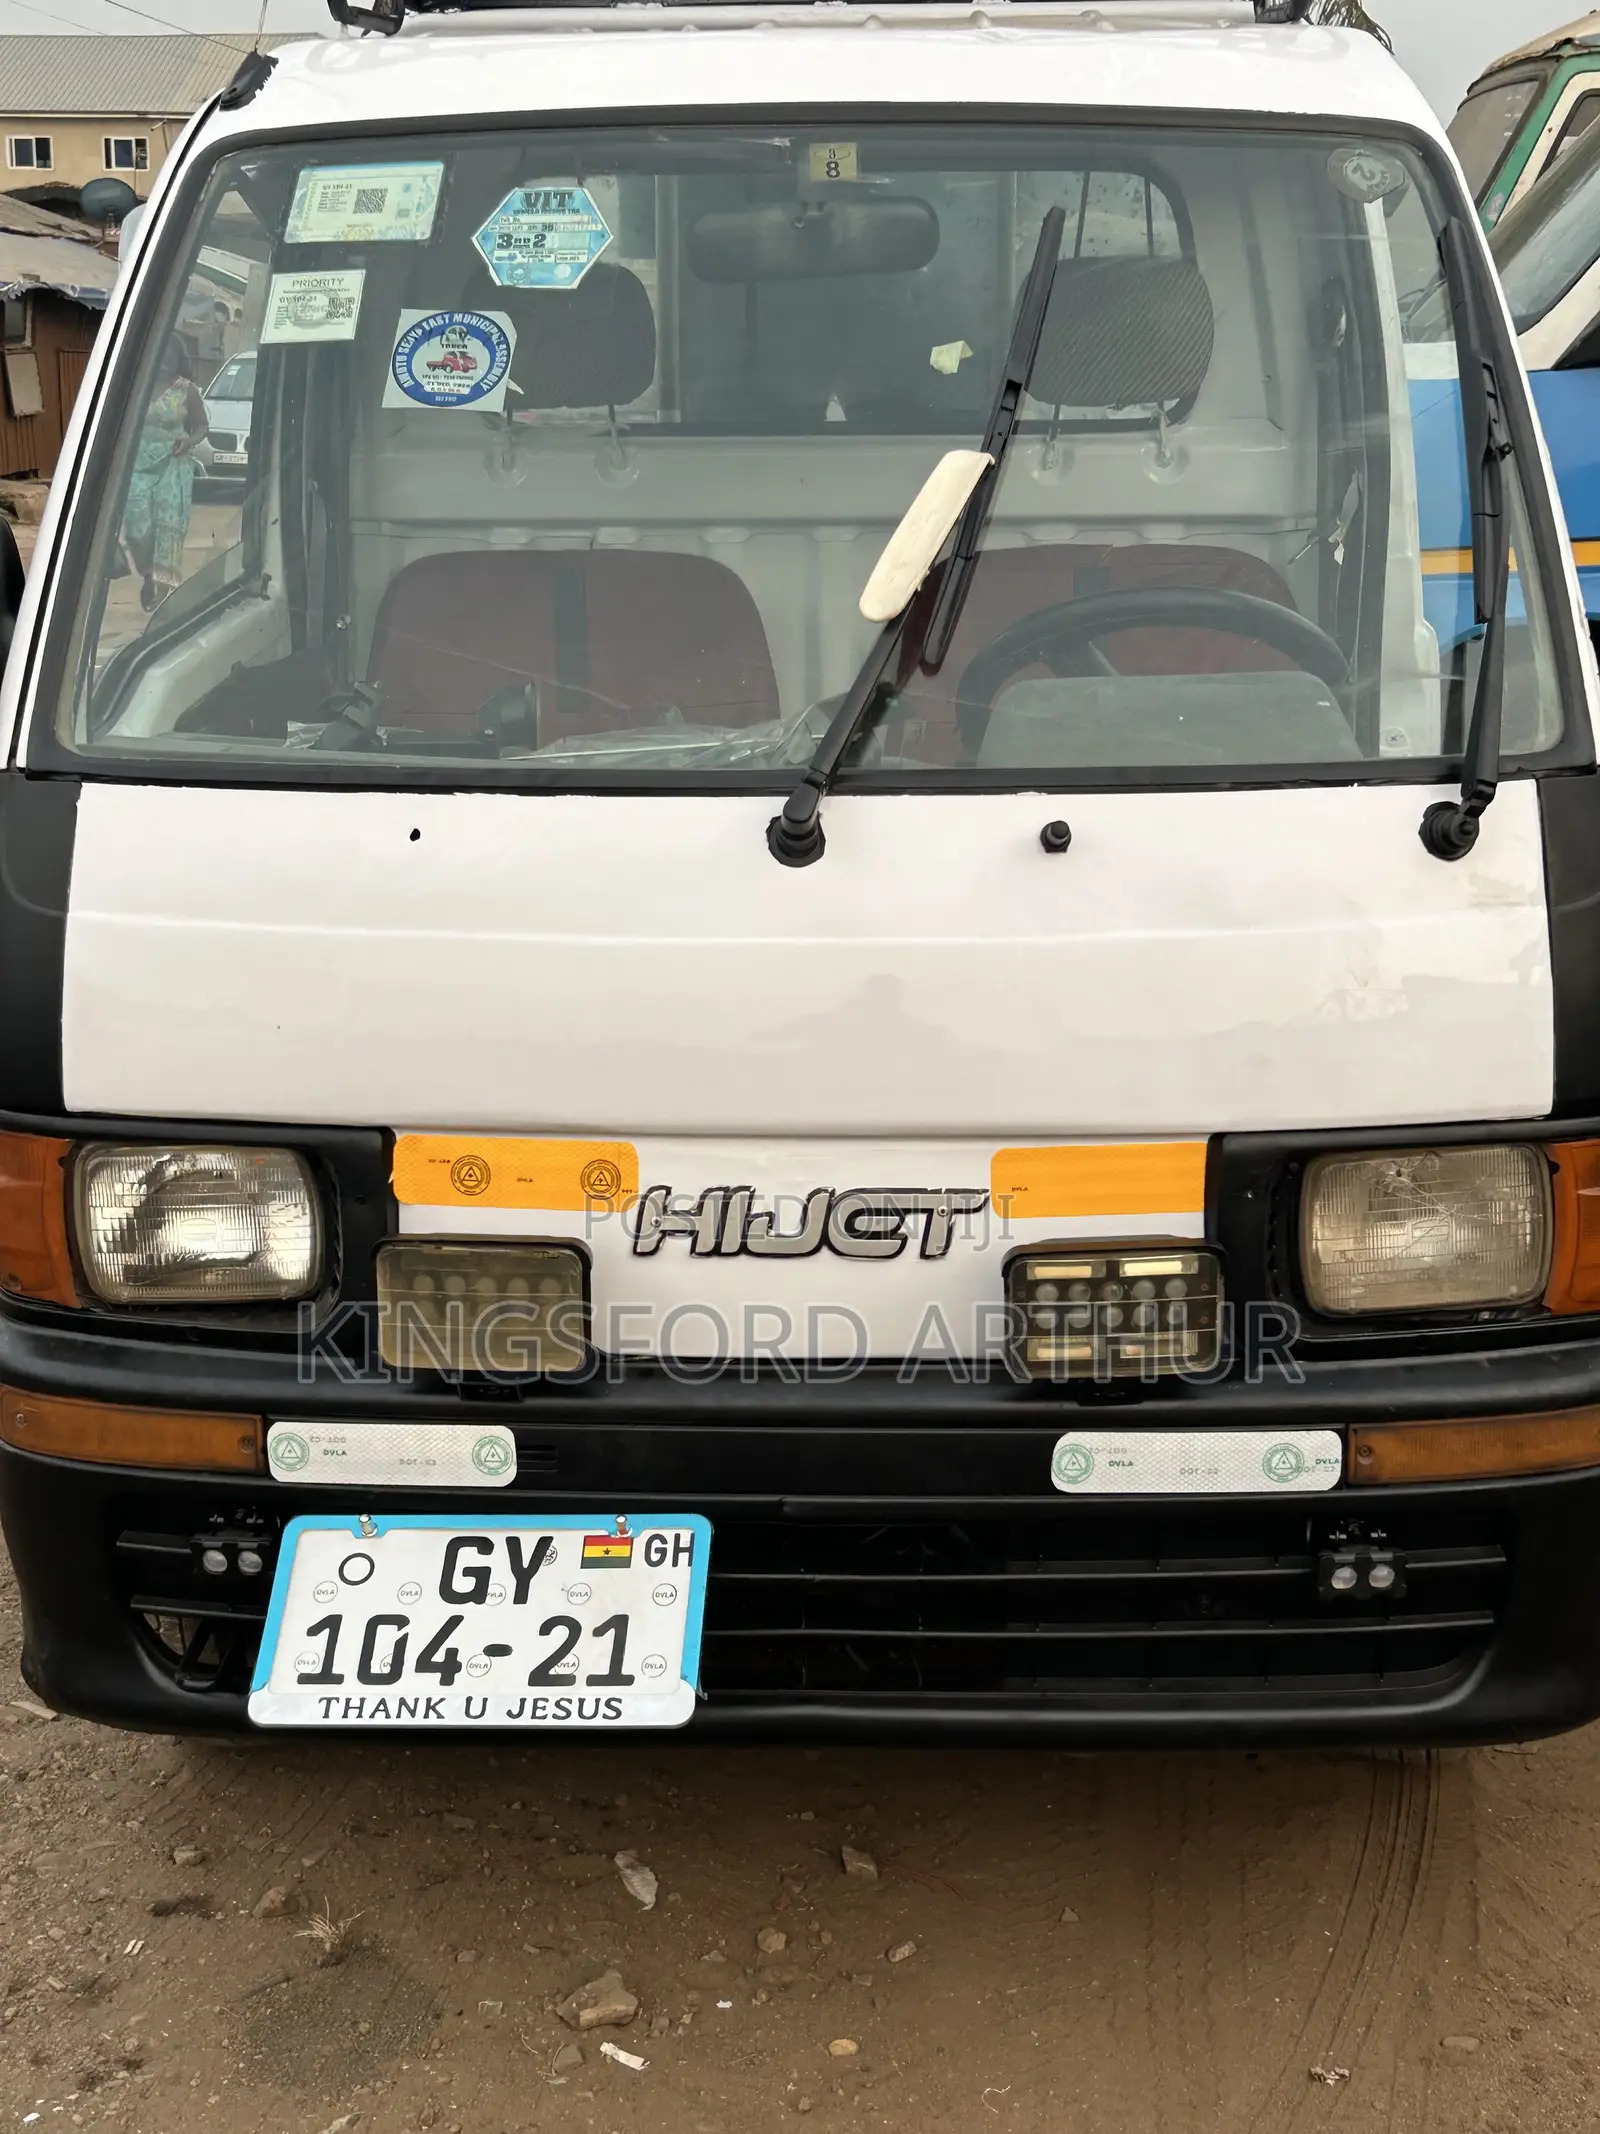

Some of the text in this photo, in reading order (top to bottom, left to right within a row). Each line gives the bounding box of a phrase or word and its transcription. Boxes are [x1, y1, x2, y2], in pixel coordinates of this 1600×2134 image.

[826, 161, 840, 178] 8
[522, 191, 576, 208] VIT
[292, 278, 345, 288] PRIORITY
[633, 1184, 990, 1260] HIJET
[644, 1532, 695, 1568] GH
[439, 1535, 554, 1605] GY
[655, 1591, 675, 1599] DVLA
[297, 1613, 636, 1687] 104-21
[318, 1695, 623, 1721] THANK U JESUS
